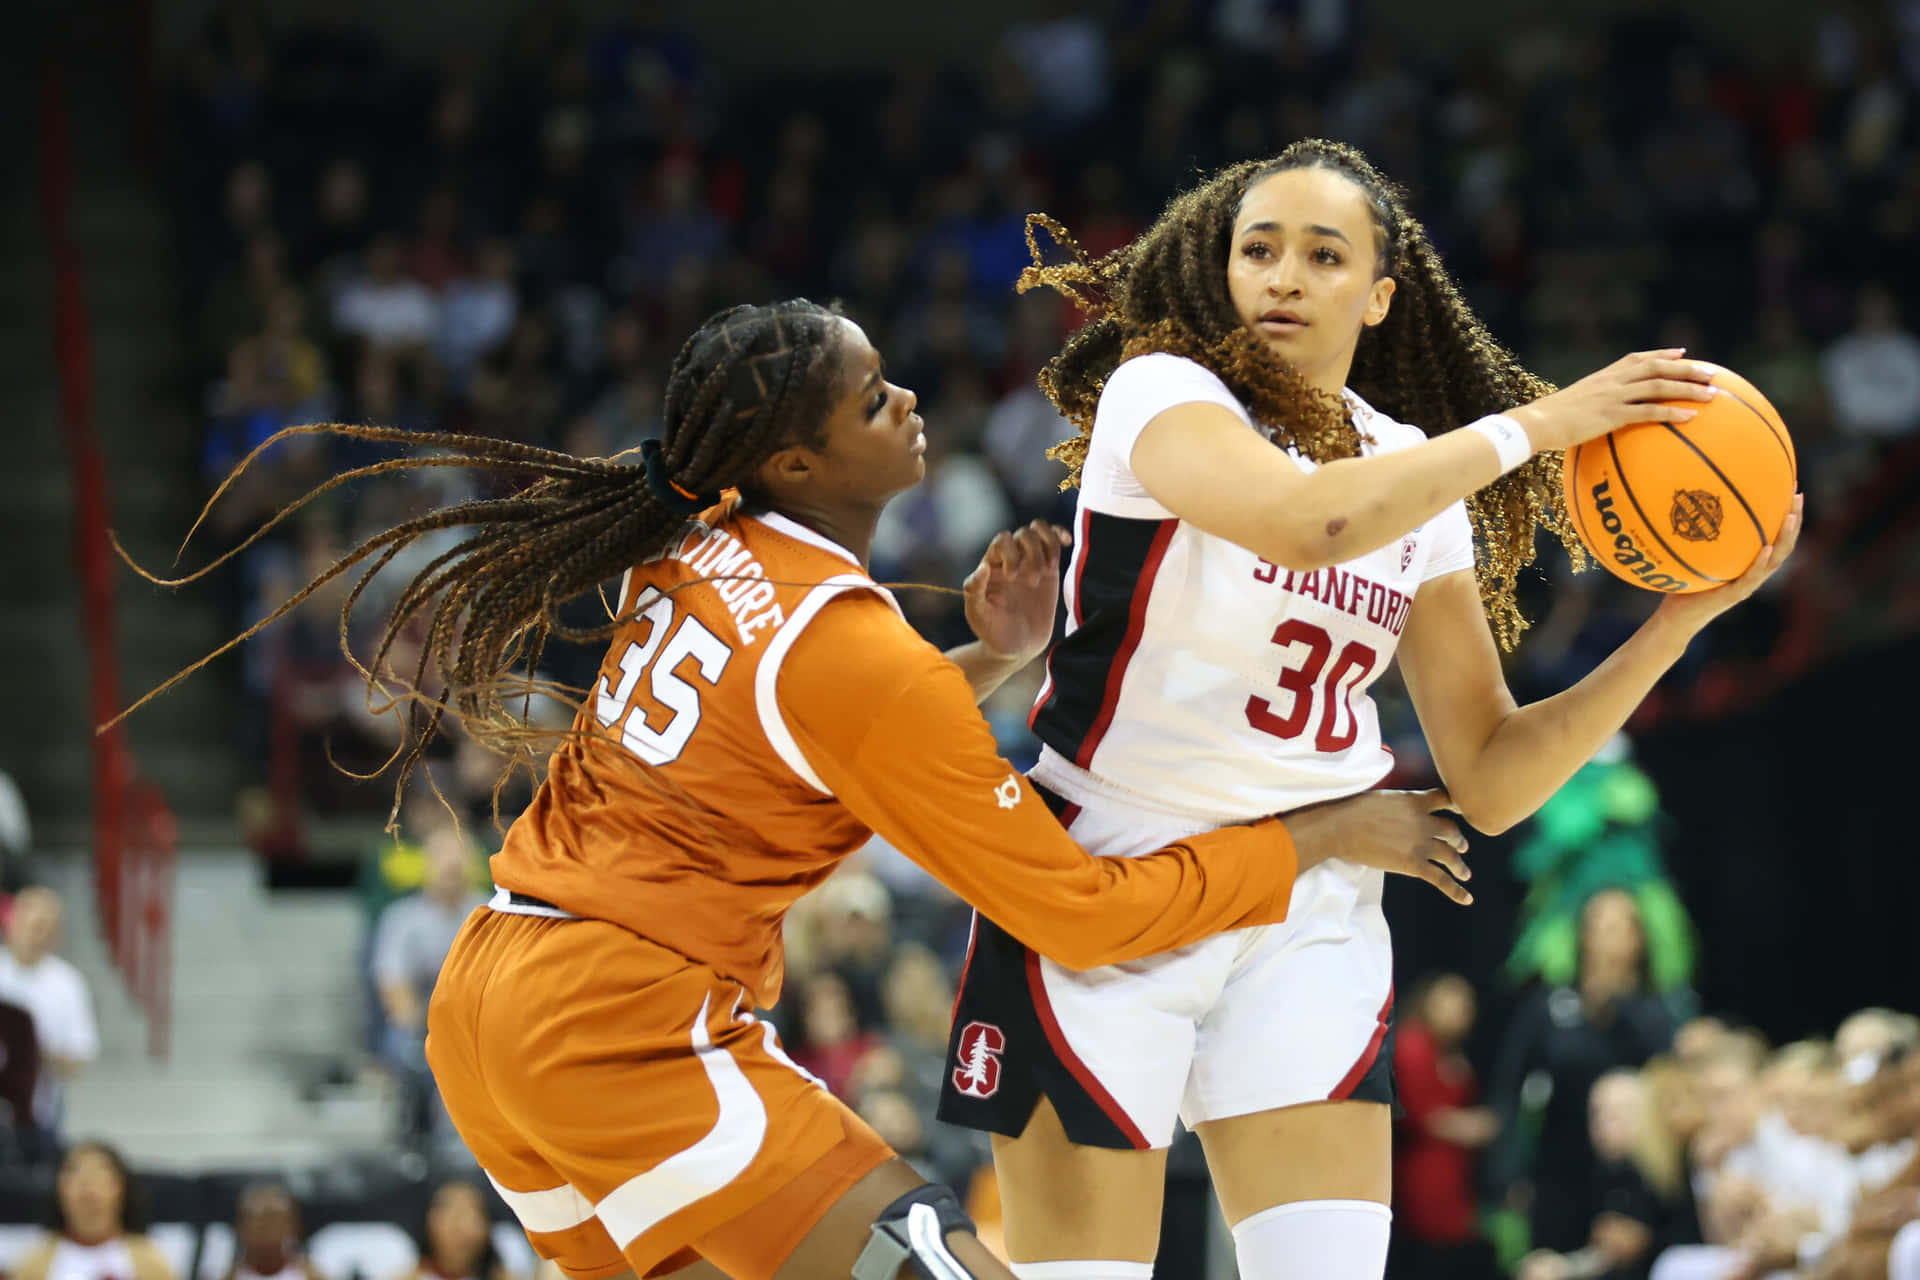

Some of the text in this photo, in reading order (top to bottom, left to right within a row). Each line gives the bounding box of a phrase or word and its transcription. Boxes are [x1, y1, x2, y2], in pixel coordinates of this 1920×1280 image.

[1592, 479, 1688, 592] Wilson
[597, 585, 733, 767] 35
[1245, 618, 1376, 752] 30
